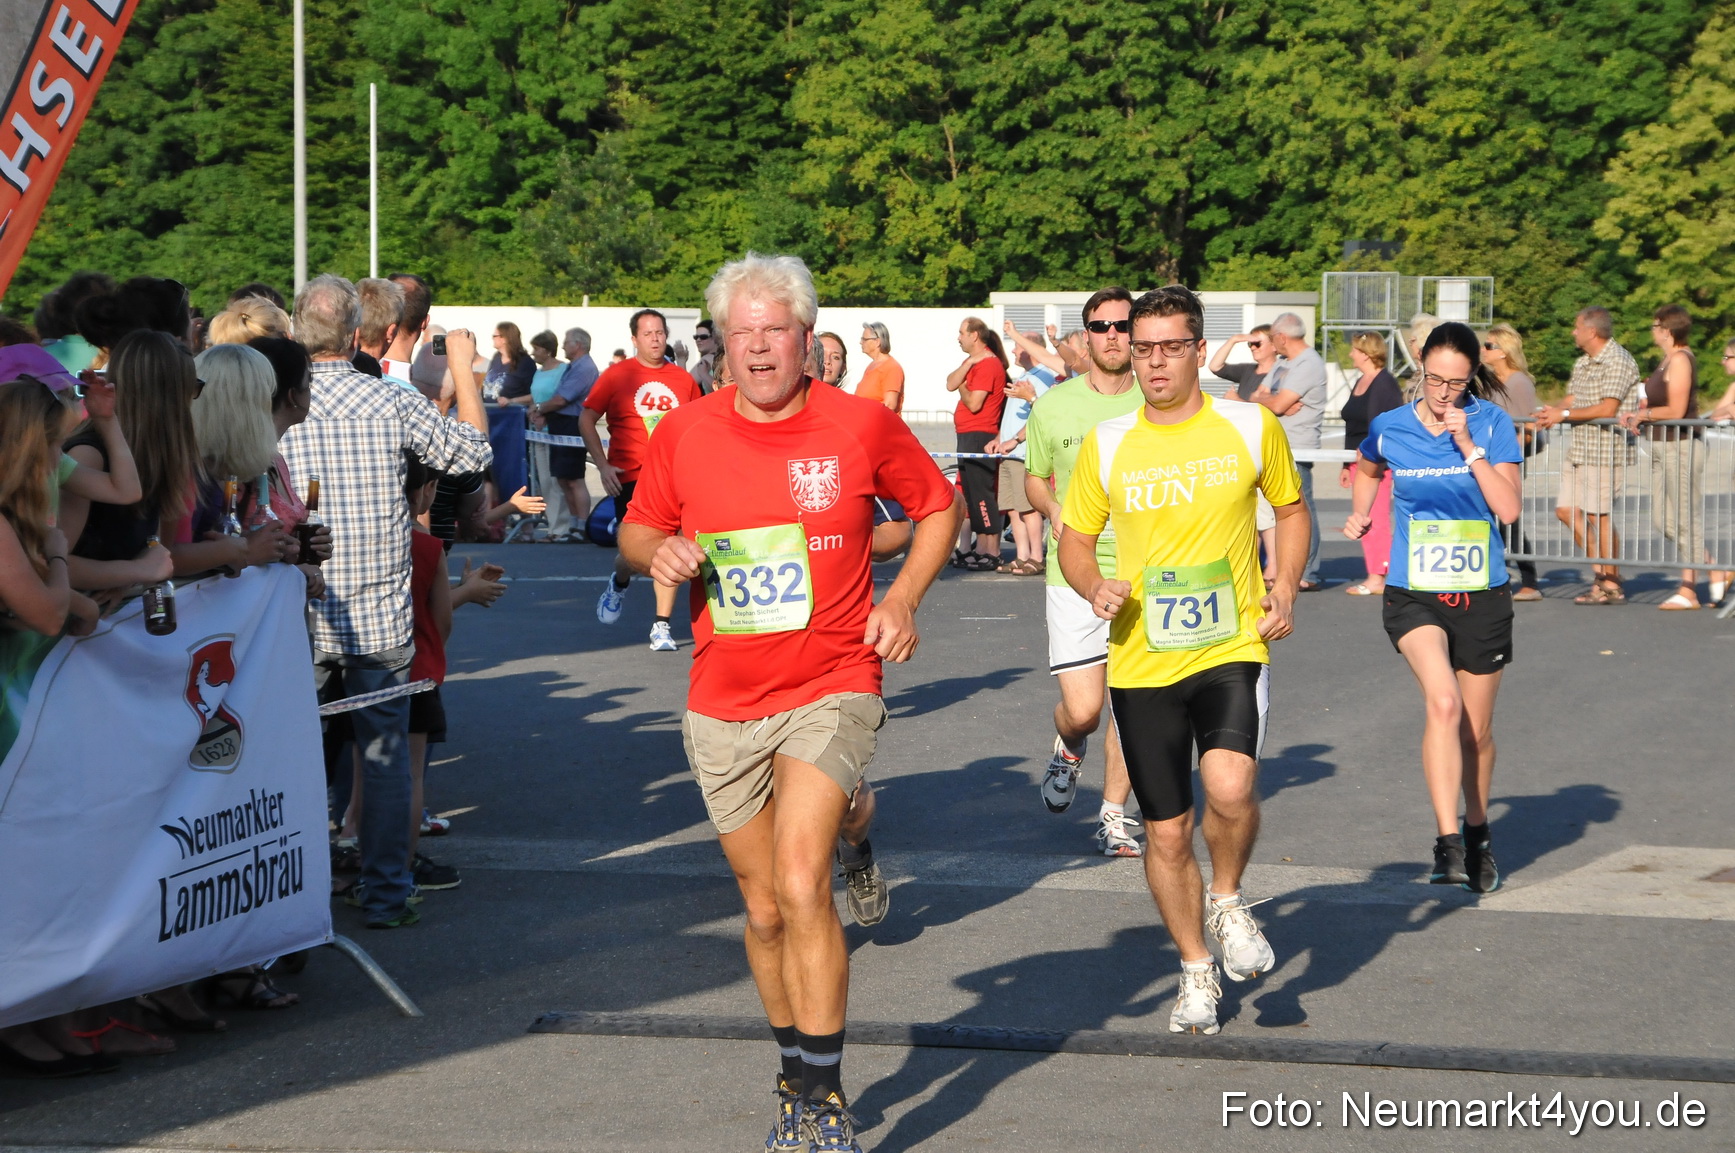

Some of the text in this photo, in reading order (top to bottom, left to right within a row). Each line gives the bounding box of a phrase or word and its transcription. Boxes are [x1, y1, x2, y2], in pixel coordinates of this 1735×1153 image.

[641, 391, 673, 411] 48
[1121, 453, 1239, 485] MAGNA STEYR
[1123, 470, 1239, 513] RUN 2014
[804, 533, 844, 551] am
[1412, 544, 1485, 573] 1250
[706, 561, 807, 608] 1332
[1155, 591, 1219, 630] 731
[1190, 625, 1218, 636] Hermsdorf
[198, 737, 236, 765] 1628
[159, 787, 284, 860] Neumarkter
[157, 834, 303, 943] Lammsbräu
